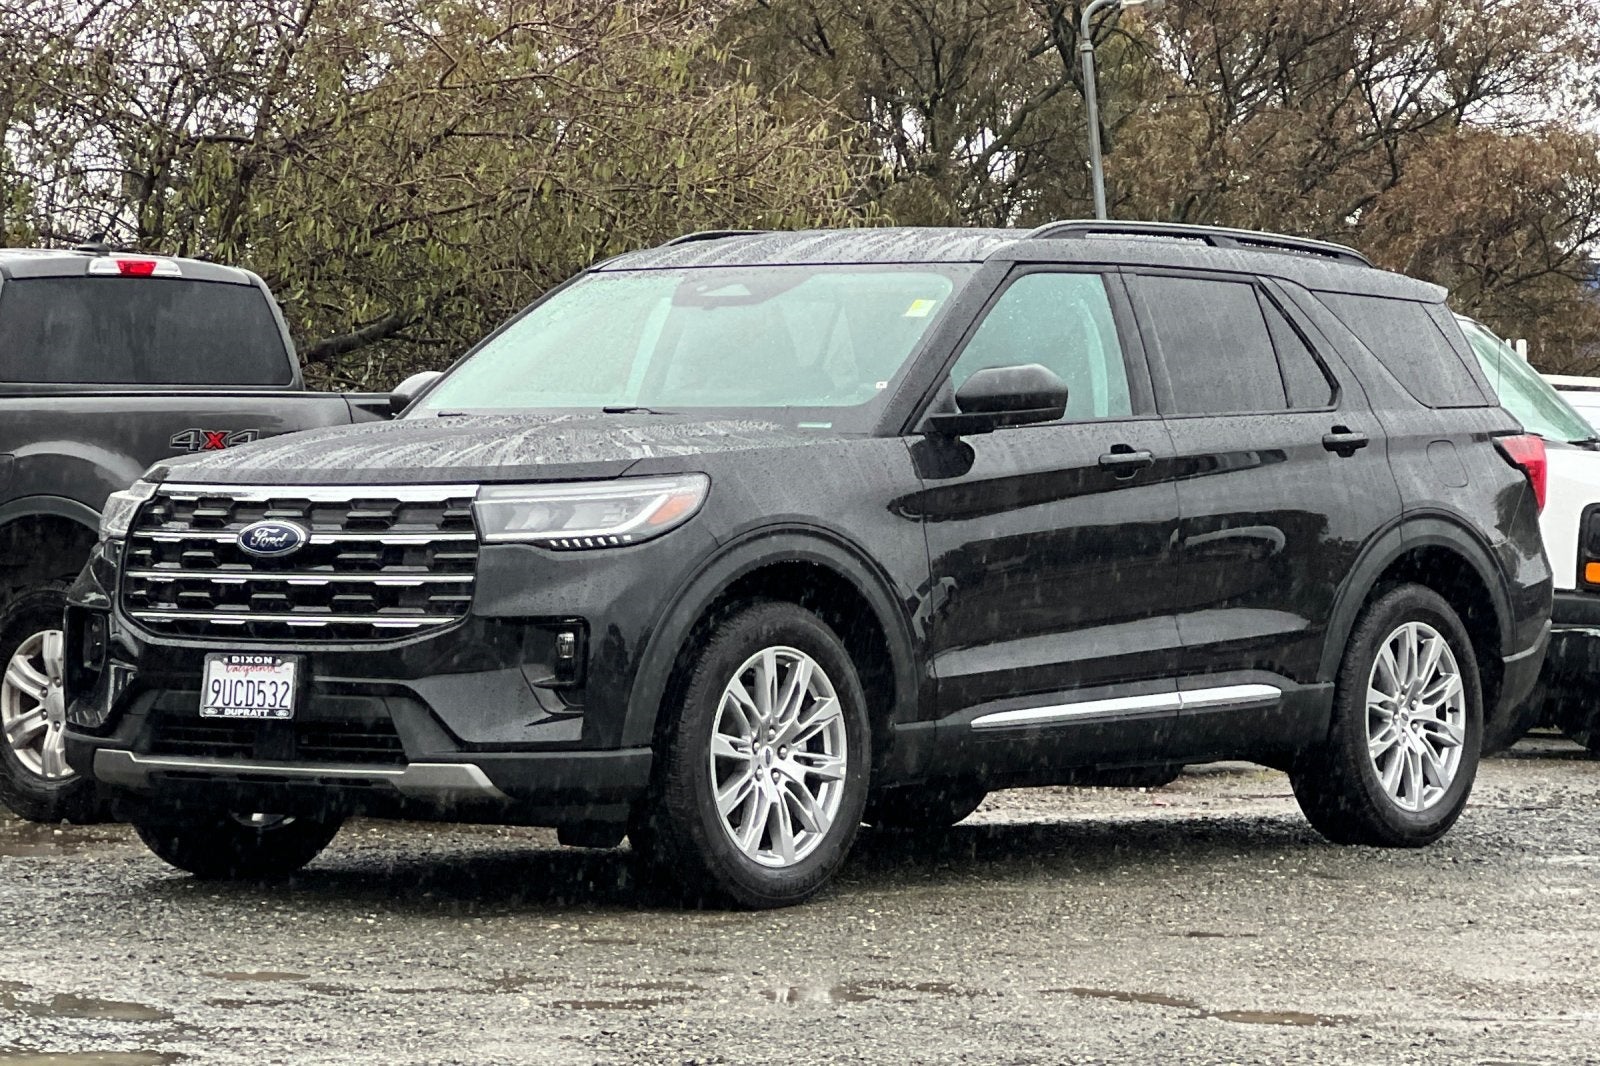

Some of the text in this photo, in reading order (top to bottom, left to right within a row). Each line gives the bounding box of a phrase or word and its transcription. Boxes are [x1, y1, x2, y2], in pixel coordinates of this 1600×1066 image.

[249, 527, 288, 547] Ford
[232, 656, 272, 664] DIXON
[211, 679, 290, 708] 9UCD532
[224, 708, 270, 716] DUPRATT
